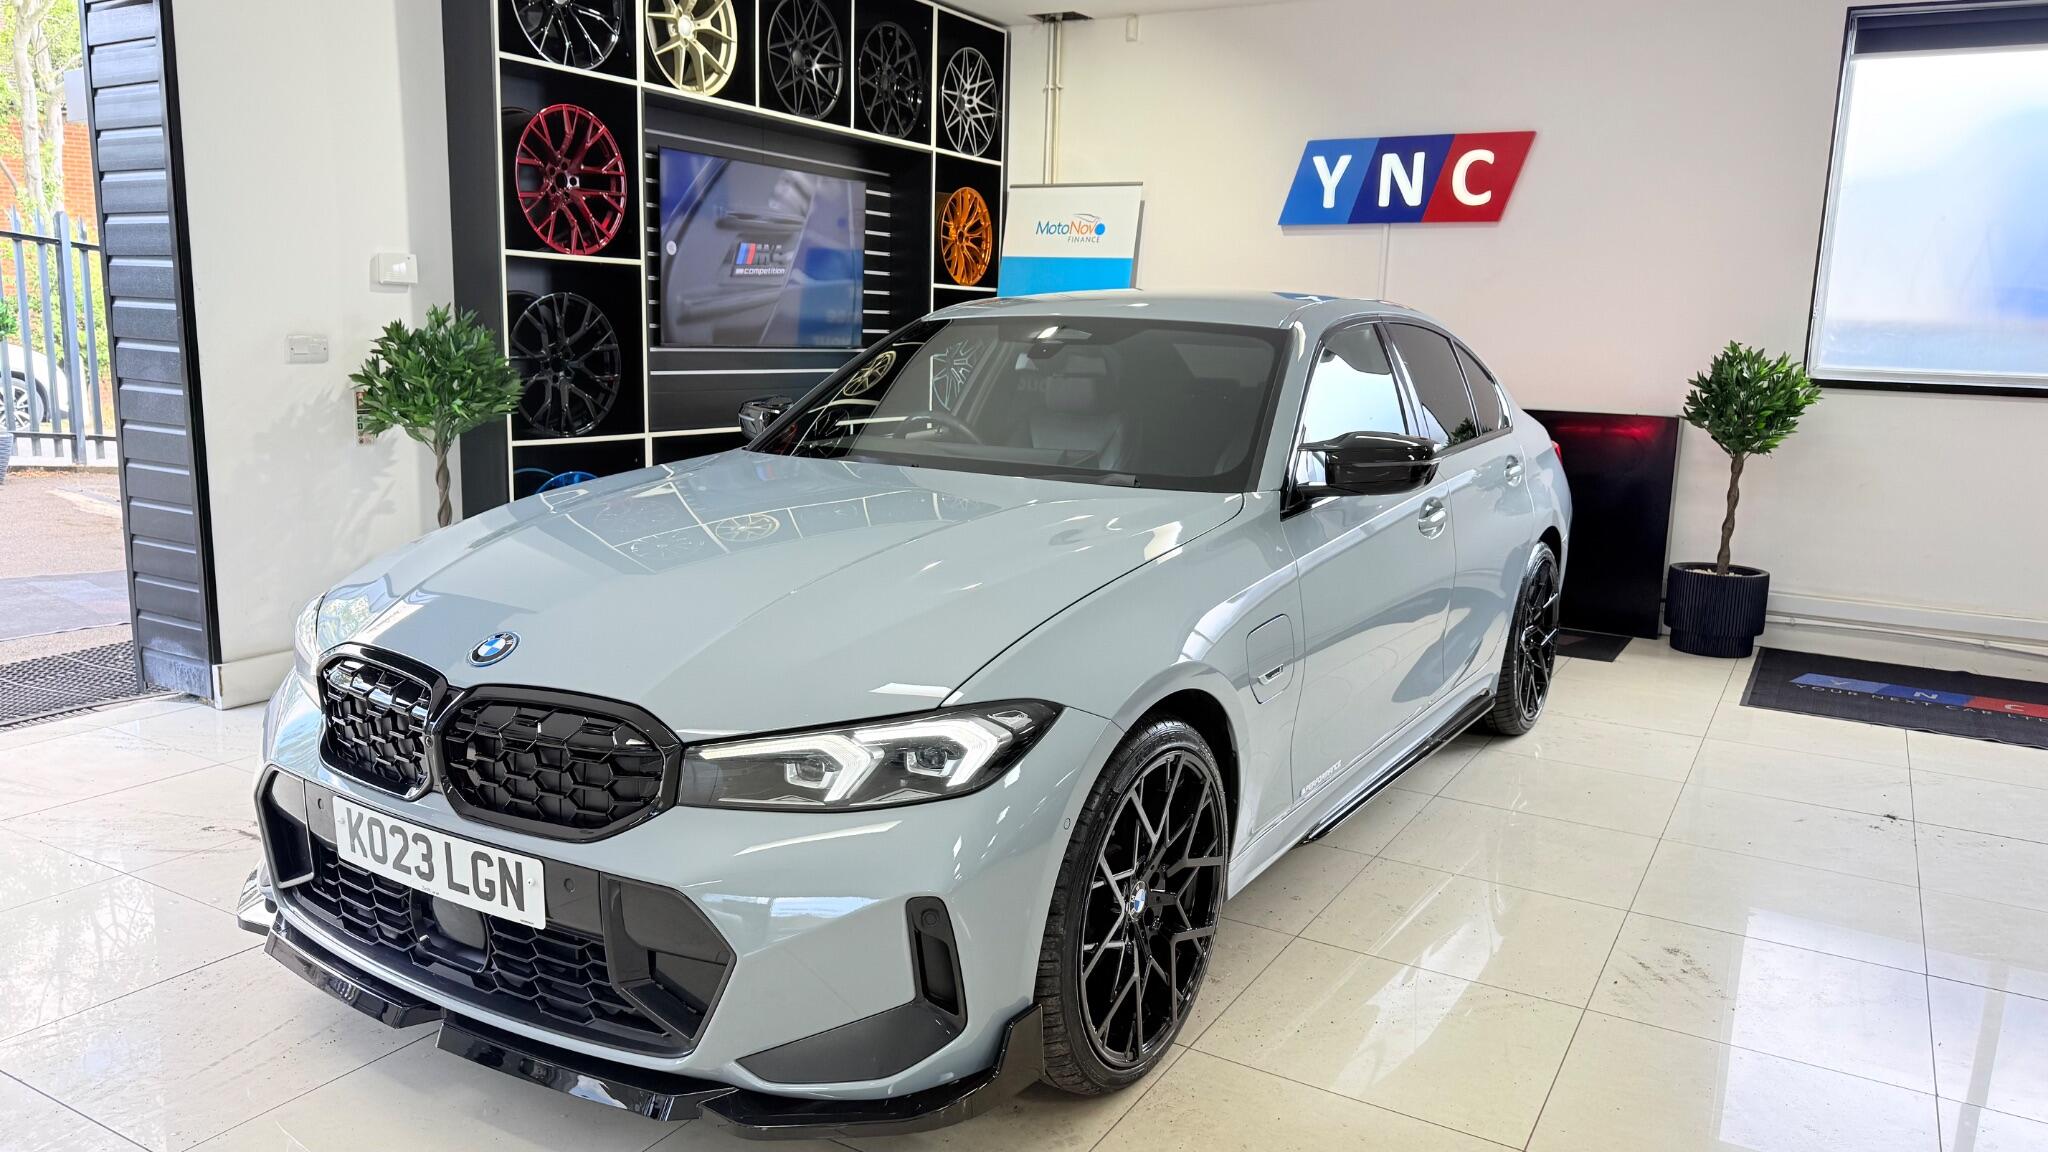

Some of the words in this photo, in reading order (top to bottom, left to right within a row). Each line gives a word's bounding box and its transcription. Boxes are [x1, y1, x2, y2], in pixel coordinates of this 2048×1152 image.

[1312, 149, 1495, 208] YNC
[1796, 684, 1858, 696] YOUR
[1871, 694, 1932, 706] NEXT
[346, 807, 434, 882] KO23
[445, 841, 525, 912] LGN
